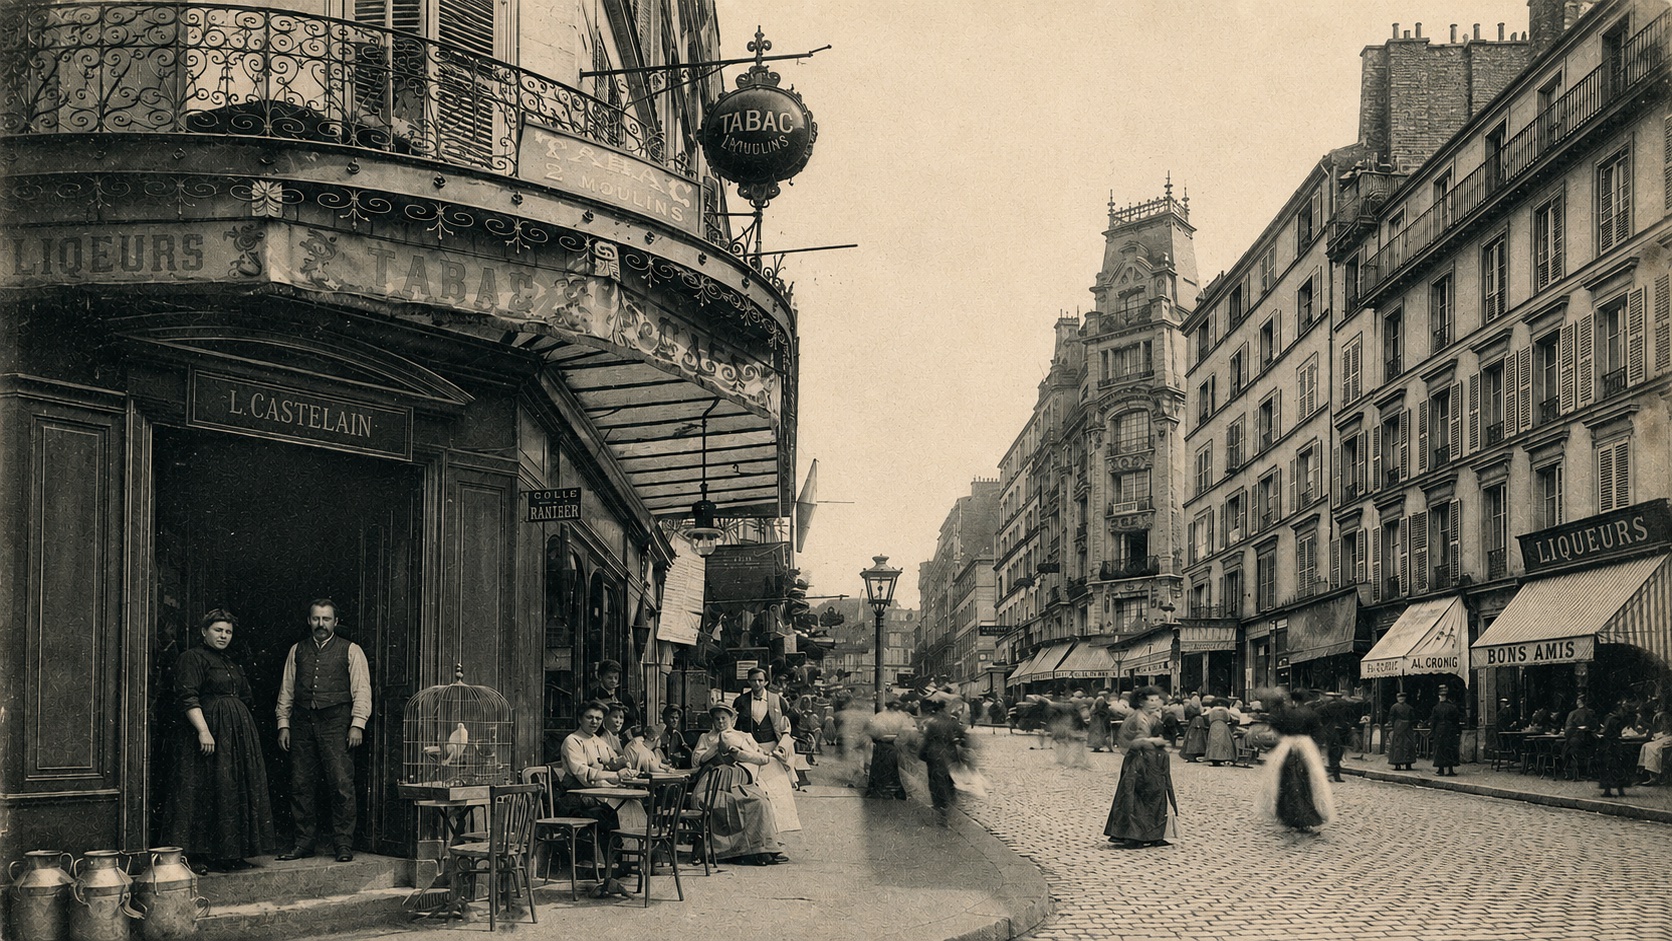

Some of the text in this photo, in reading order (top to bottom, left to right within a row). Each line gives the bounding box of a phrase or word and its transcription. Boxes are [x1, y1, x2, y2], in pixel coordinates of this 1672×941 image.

[720, 109, 794, 134] TABAC
[544, 162, 683, 222] 2 MOULINS
[12, 233, 204, 279] LIQEURS
[250, 392, 373, 438] CASTELAIN
[533, 490, 577, 500] COLLE
[1536, 515, 1649, 564] LIQUEURS
[1487, 641, 1575, 664] BONS AMIS
